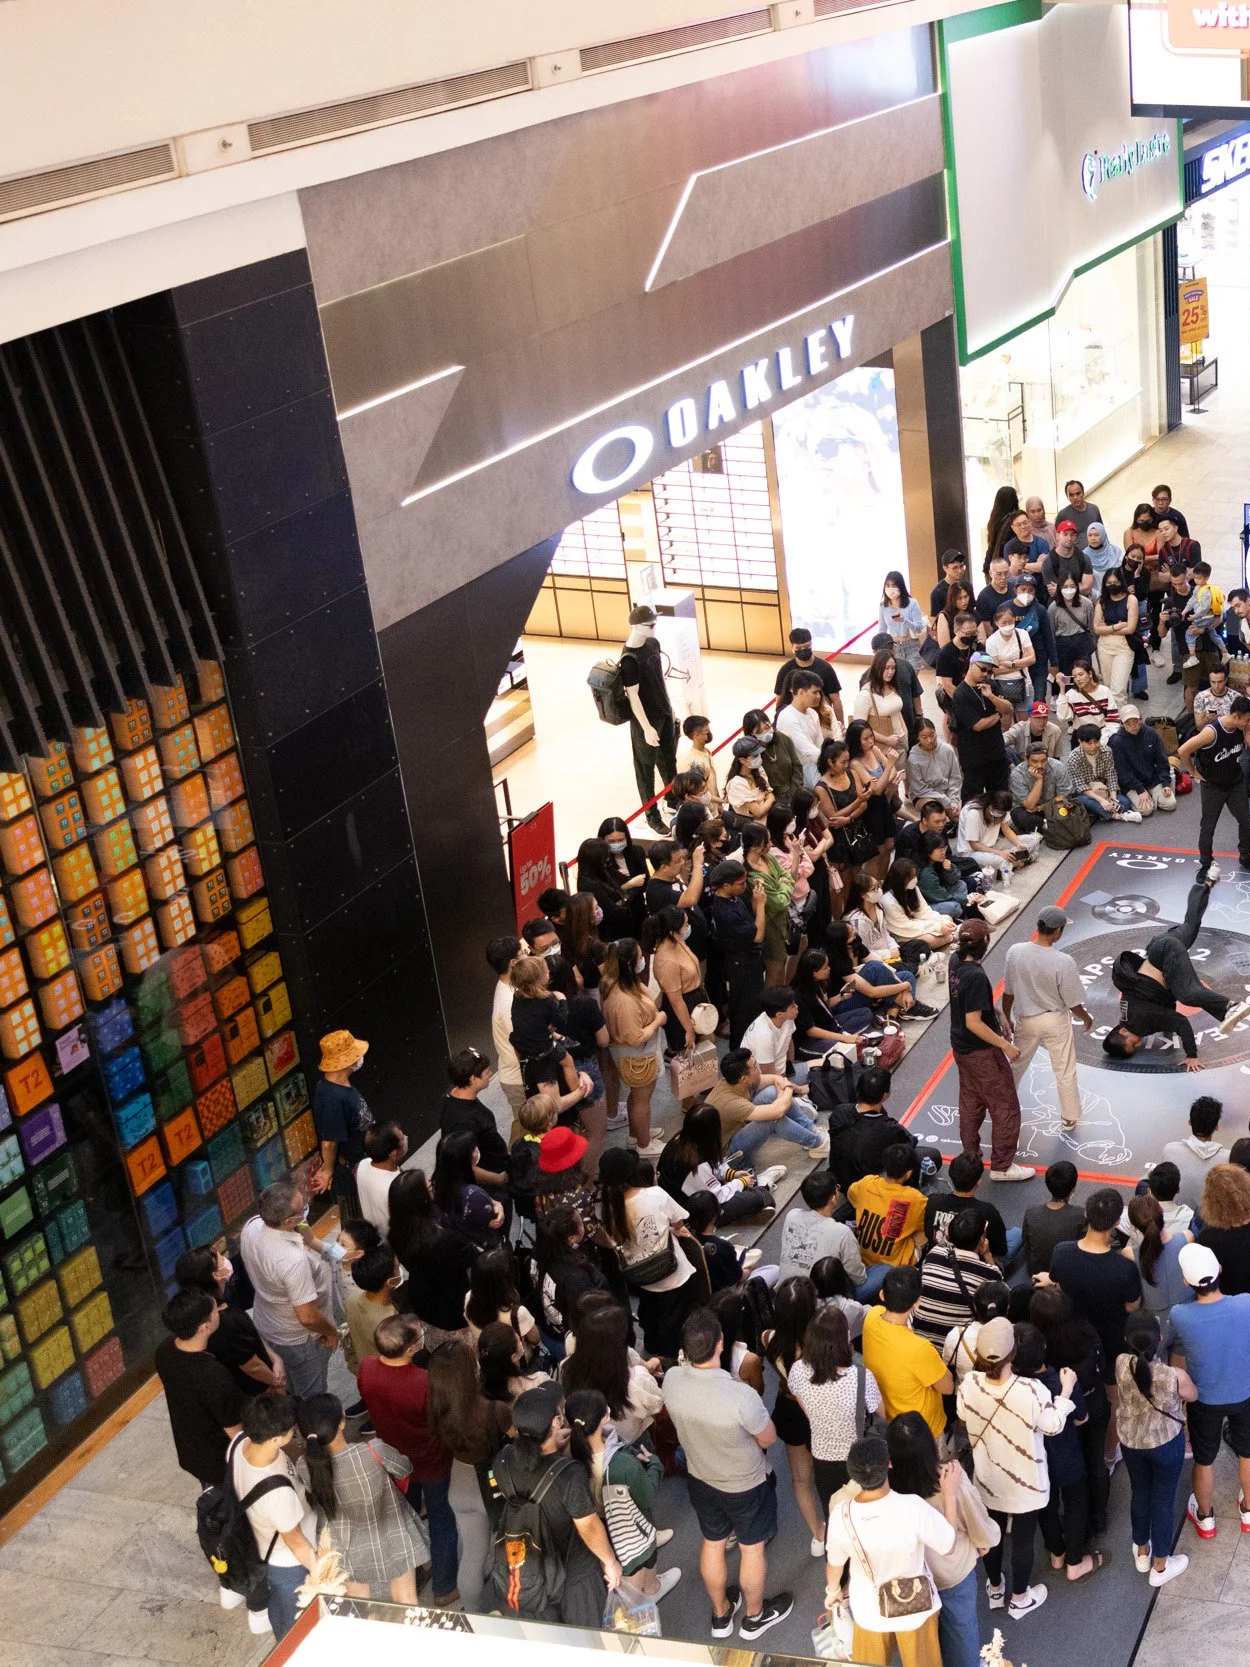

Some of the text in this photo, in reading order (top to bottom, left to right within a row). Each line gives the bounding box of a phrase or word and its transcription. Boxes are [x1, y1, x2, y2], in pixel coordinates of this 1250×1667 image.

[665, 314, 855, 448] OAKLEY
[1108, 852, 1185, 864] OAKLEY
[520, 855, 551, 895] 50%
[19, 1069, 43, 1094] T2
[174, 1124, 195, 1147] T2
[137, 1153, 157, 1178] T2
